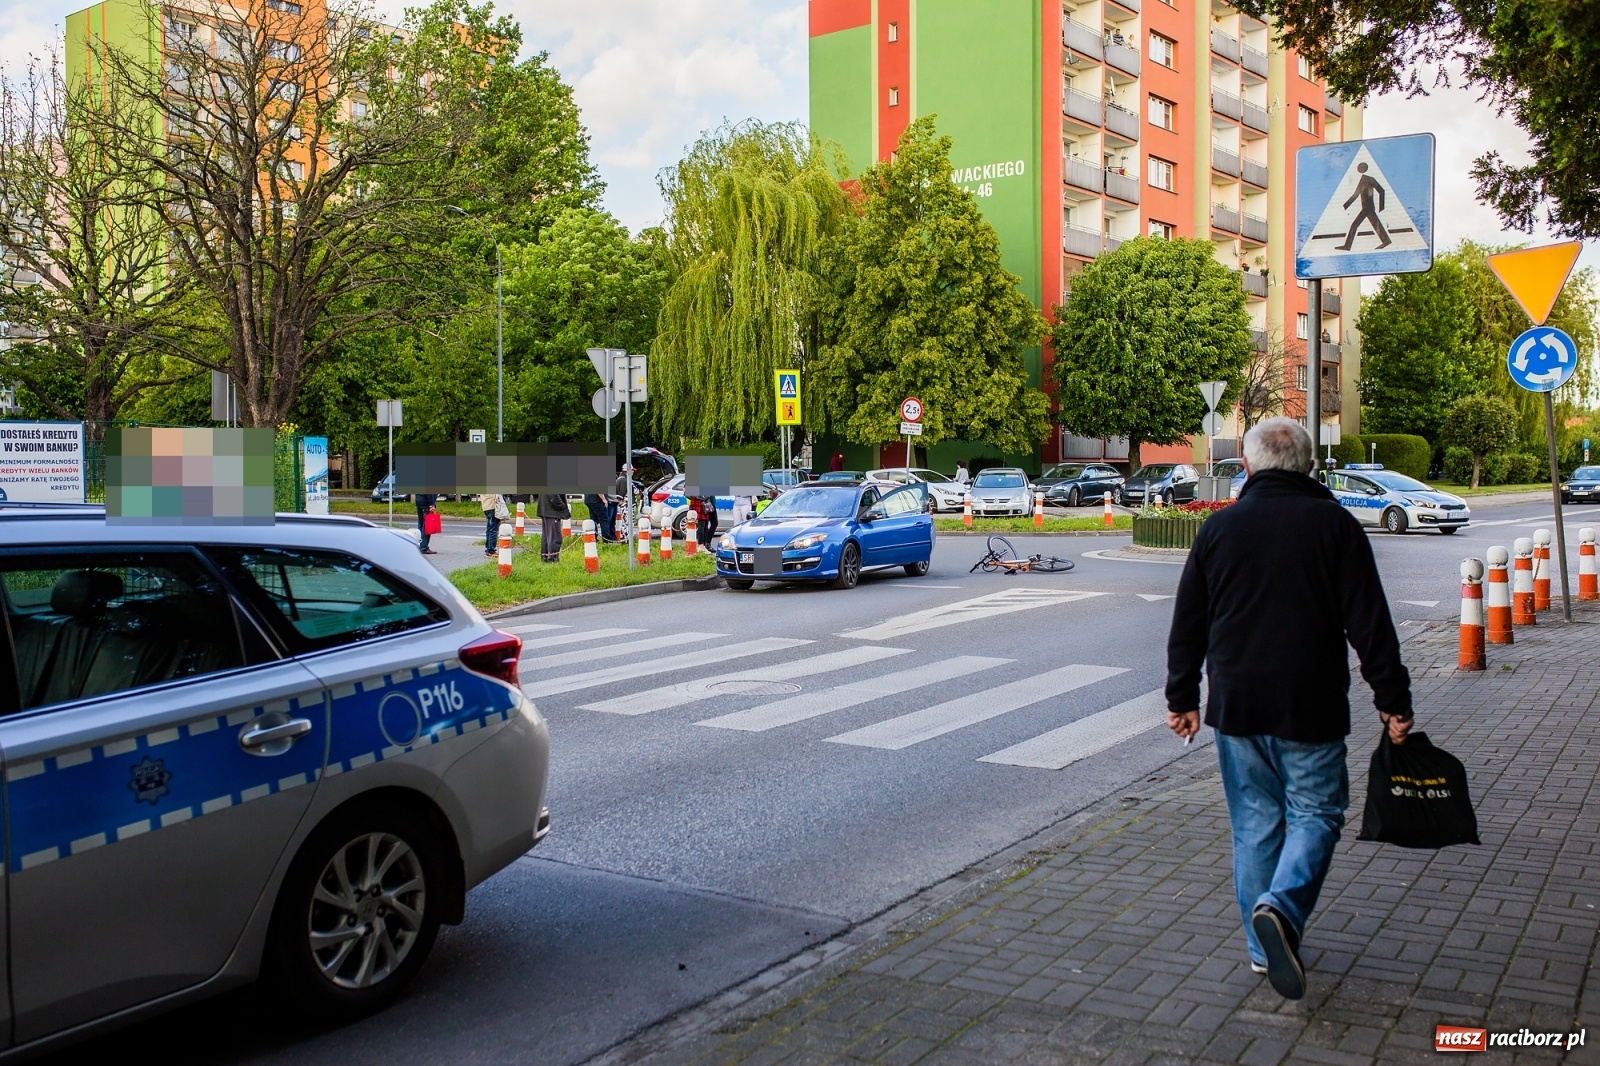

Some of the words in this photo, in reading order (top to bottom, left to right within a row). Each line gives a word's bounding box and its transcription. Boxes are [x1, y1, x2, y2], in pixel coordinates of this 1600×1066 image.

[0, 428, 41, 439] DOSTAŁEŚ
[42, 430, 78, 439] KREDYTU
[4, 443, 13, 452] W
[14, 443, 45, 452] SWOIM
[46, 443, 79, 452] BANKU?
[306, 444, 322, 454] AUTO
[1341, 498, 1368, 506] POLICJA
[417, 681, 464, 719] P116
